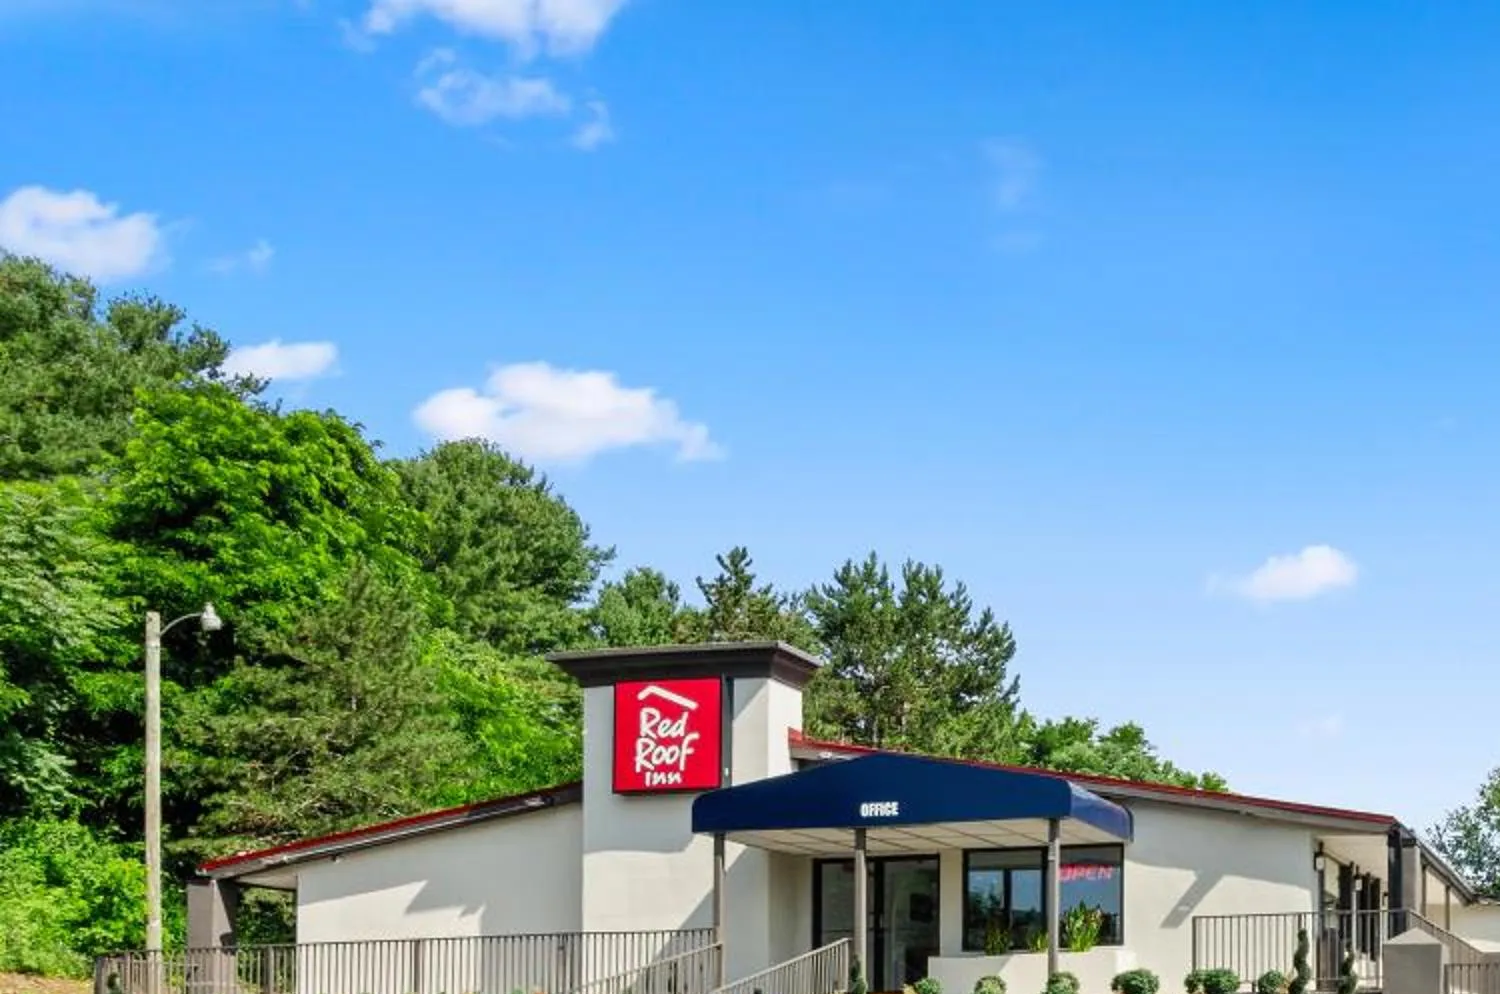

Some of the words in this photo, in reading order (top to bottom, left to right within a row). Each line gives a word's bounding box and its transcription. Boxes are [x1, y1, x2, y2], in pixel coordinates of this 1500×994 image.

[640, 707, 688, 738] Red
[635, 733, 699, 772] Roof
[860, 801, 899, 817] OFFICE
[1058, 864, 1112, 881] OPEN
